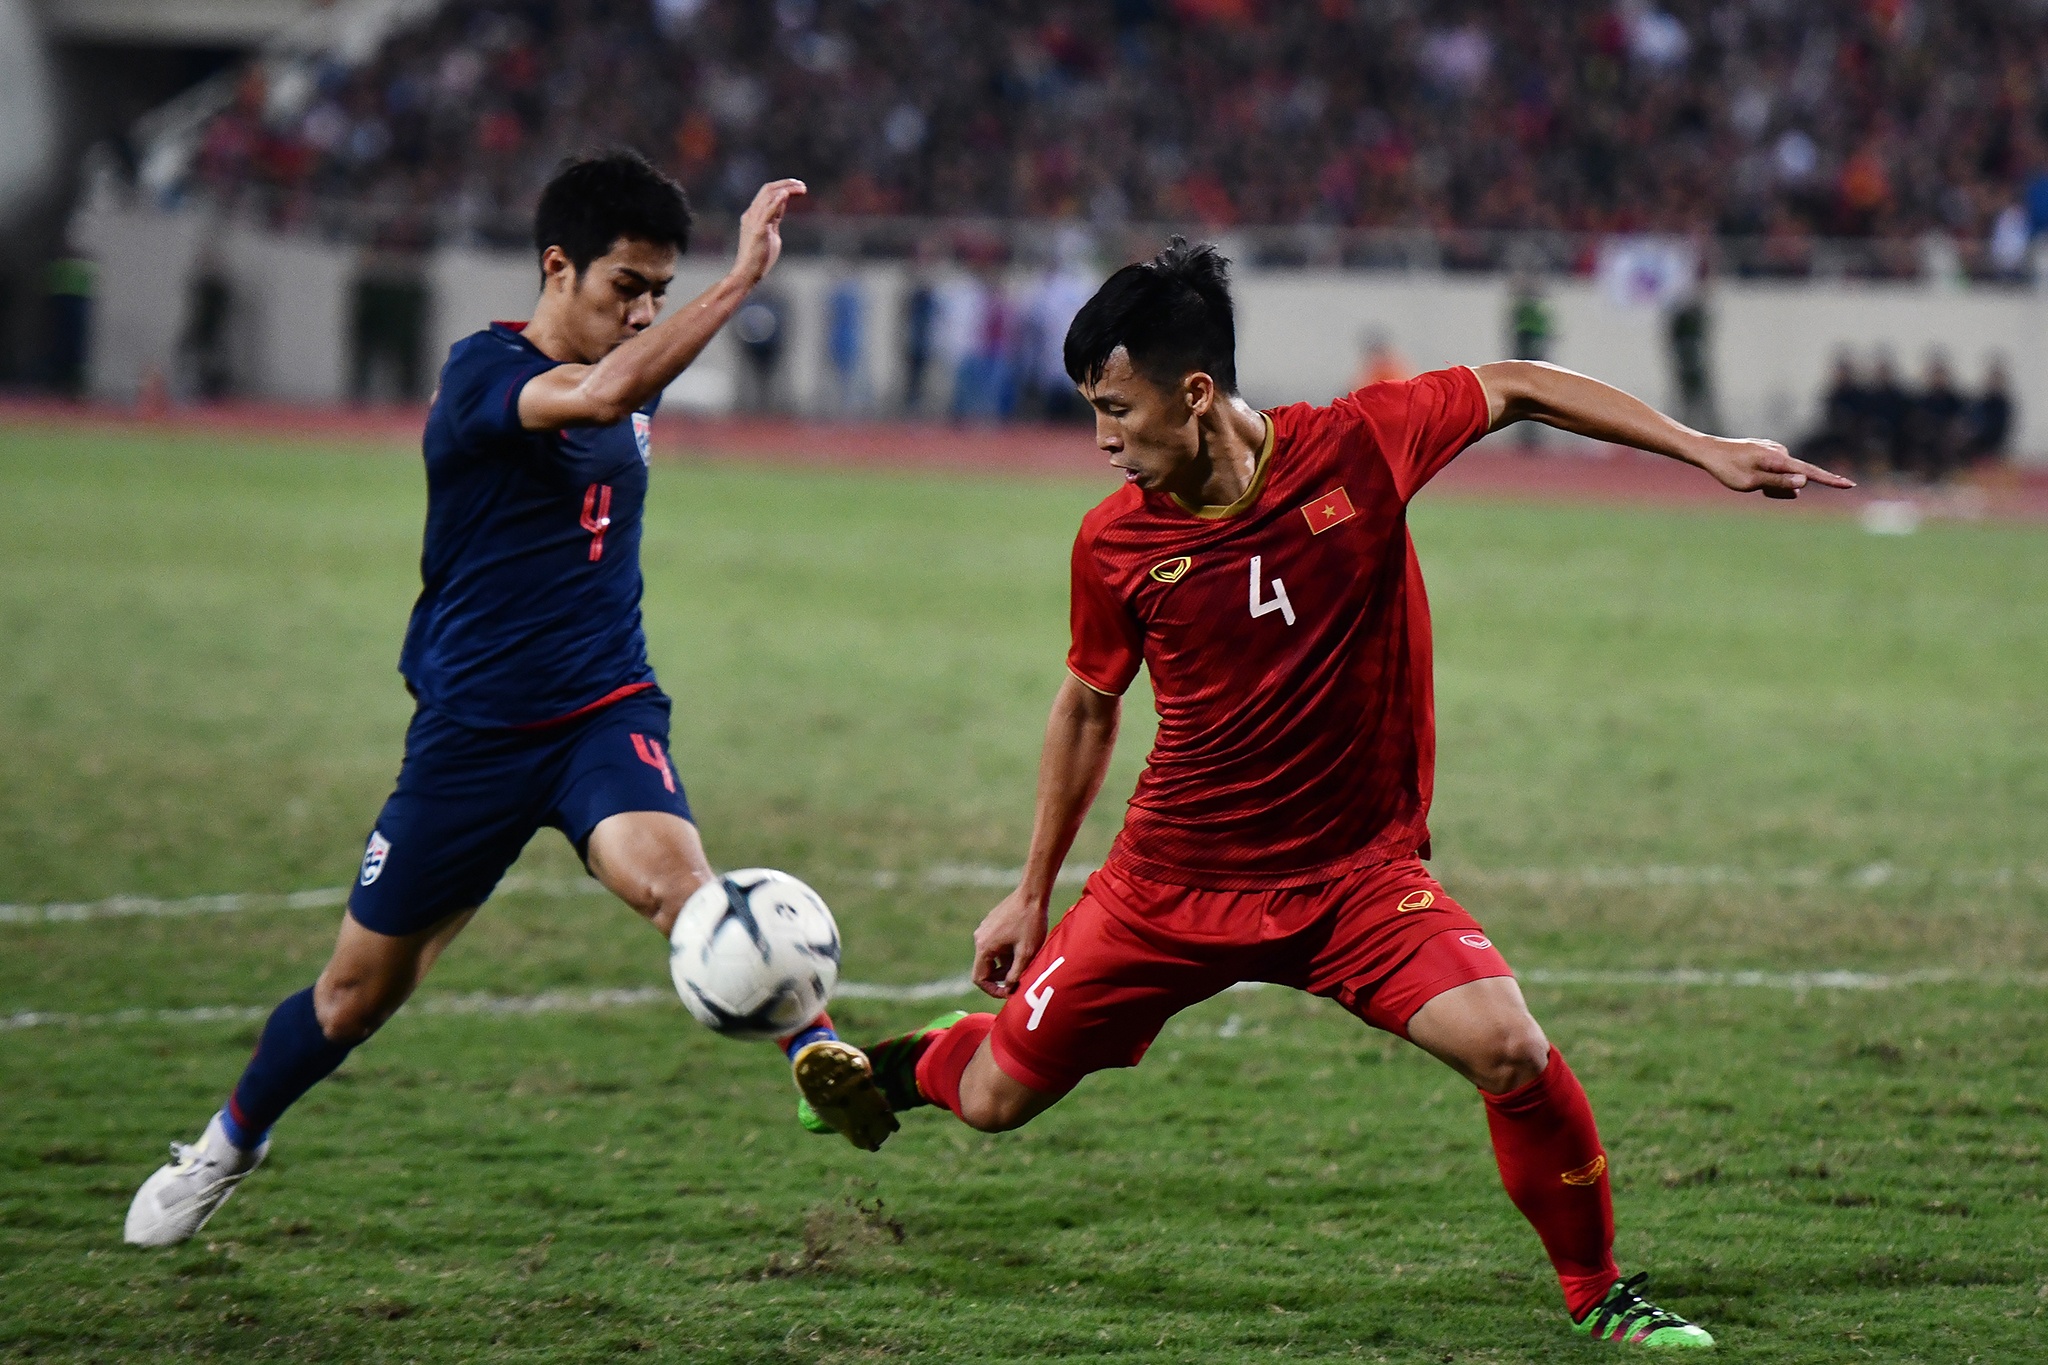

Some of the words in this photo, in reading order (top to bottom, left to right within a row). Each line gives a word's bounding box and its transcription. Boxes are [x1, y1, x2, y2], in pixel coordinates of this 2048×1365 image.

[580, 484, 612, 561] 4
[1249, 555, 1296, 626] 4
[629, 733, 676, 793] 4
[1024, 956, 1066, 1031] 4
